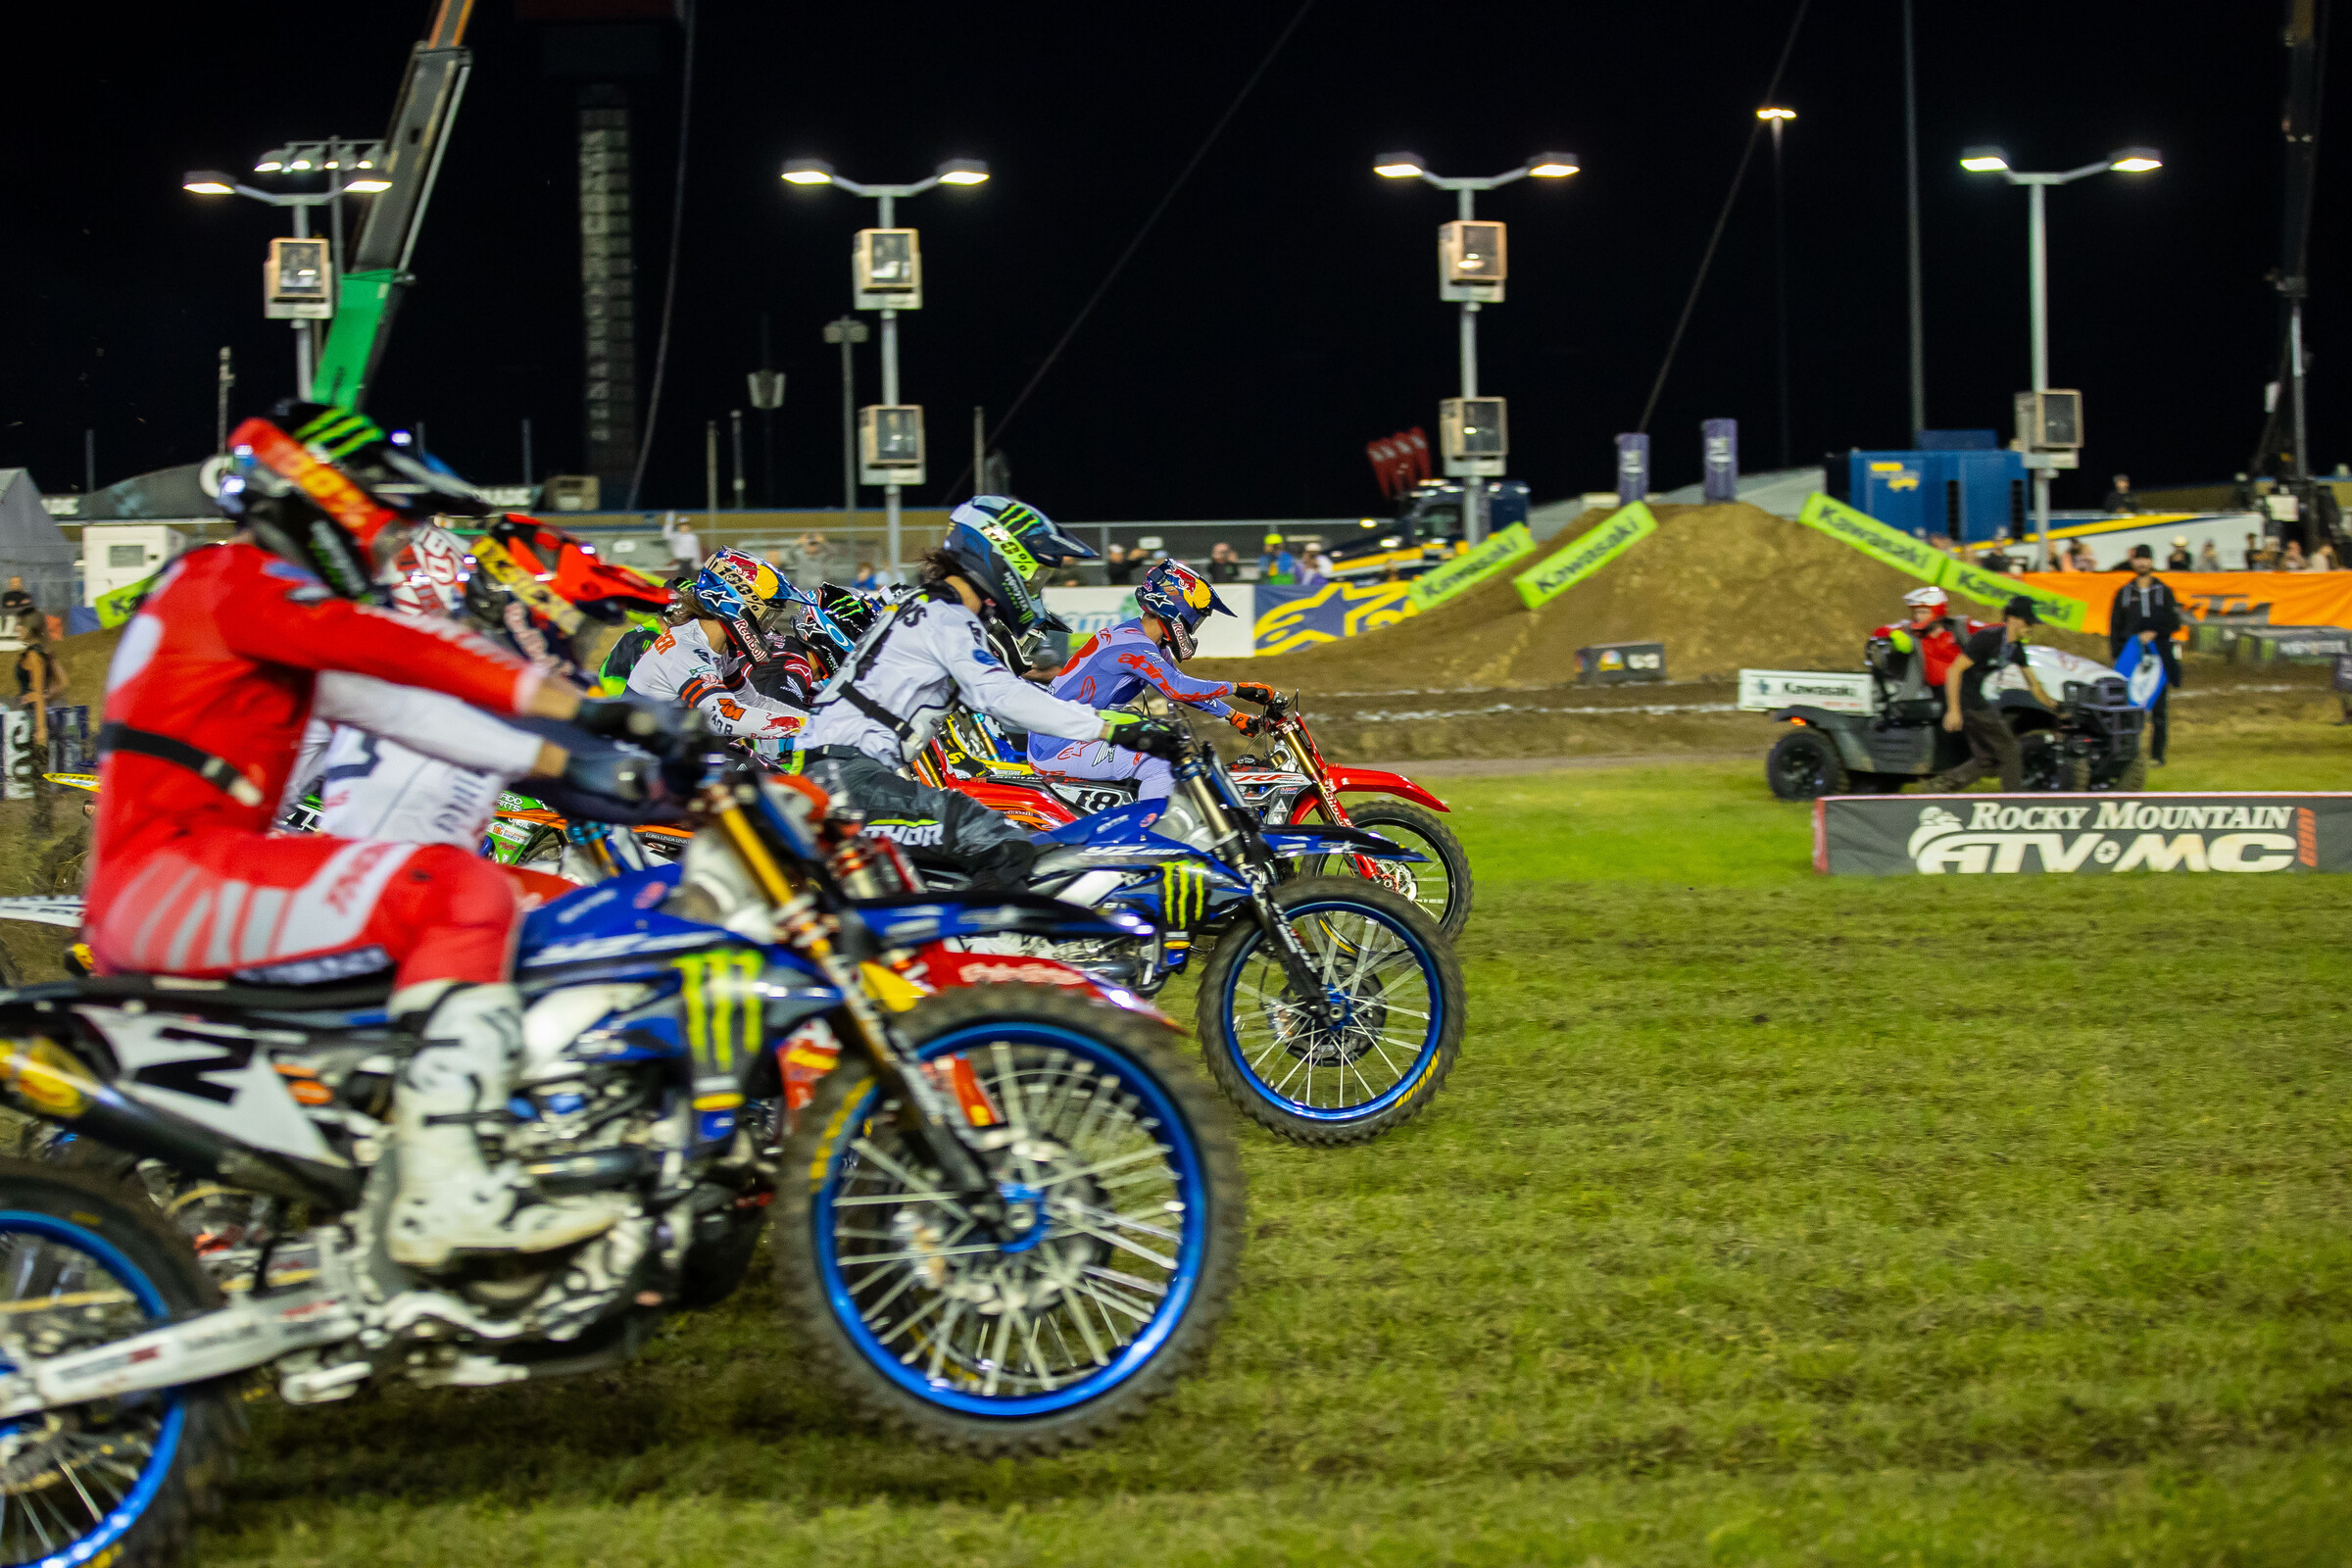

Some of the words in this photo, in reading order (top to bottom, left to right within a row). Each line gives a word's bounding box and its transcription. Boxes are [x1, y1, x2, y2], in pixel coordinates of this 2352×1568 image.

[1534, 515, 1639, 595] Kawasaki
[717, 566, 763, 612] 100%
[1958, 570, 2074, 622] Kawaki
[1782, 681, 1857, 698] Kawasaki
[1075, 790, 1121, 812] 18
[1967, 802, 2090, 831] ROCKY
[2091, 802, 2295, 831] MOUNTAIN
[864, 824, 944, 847] THOR
